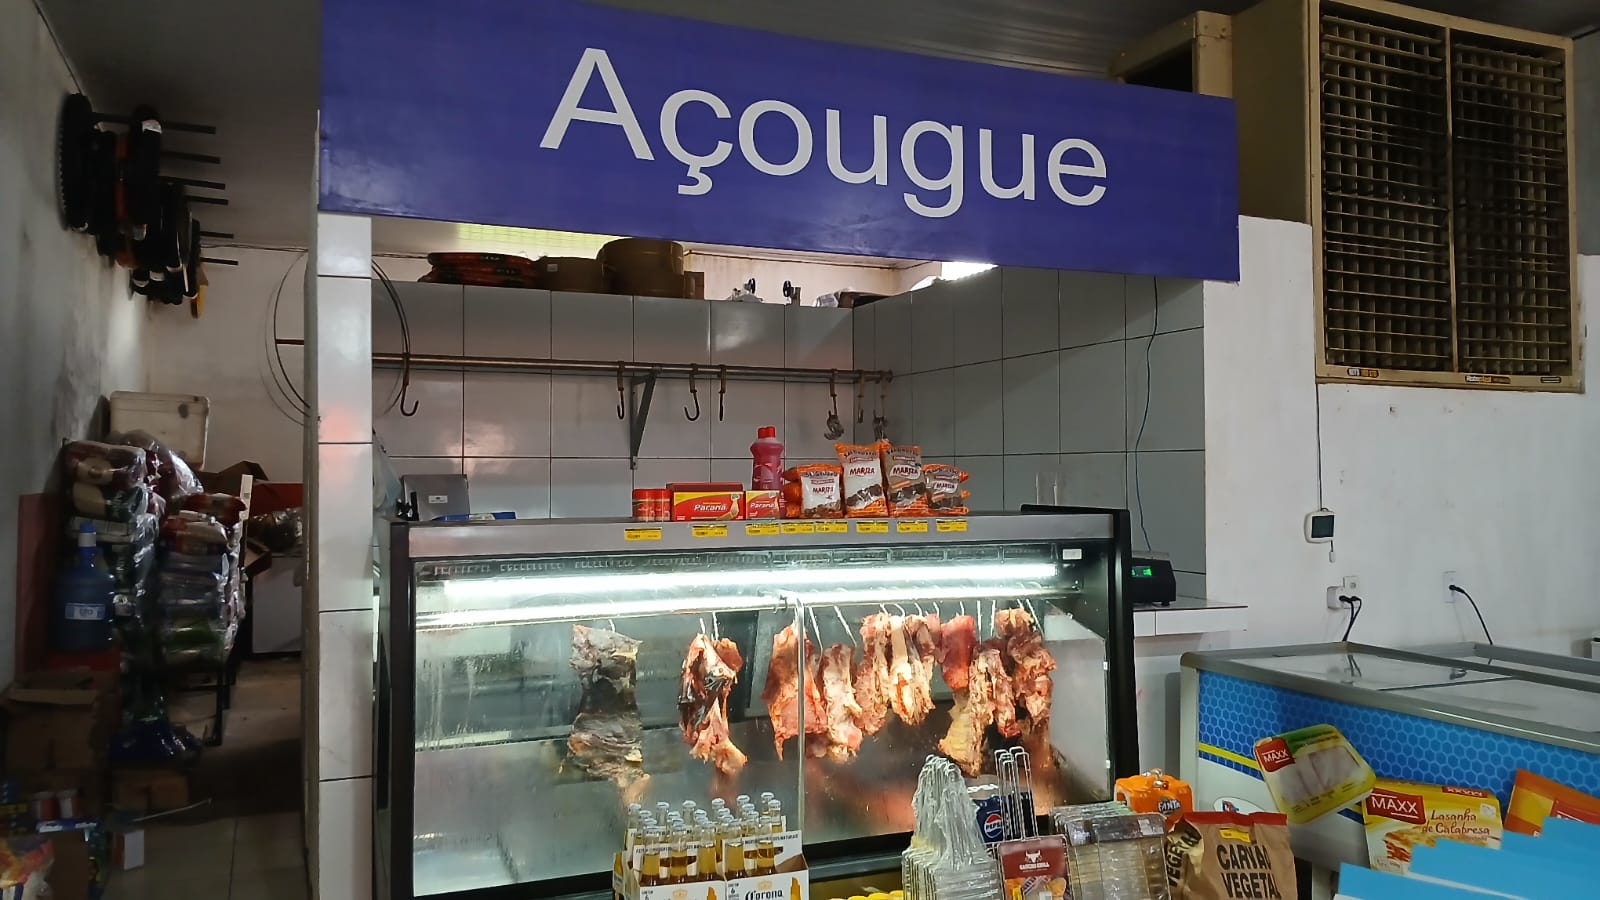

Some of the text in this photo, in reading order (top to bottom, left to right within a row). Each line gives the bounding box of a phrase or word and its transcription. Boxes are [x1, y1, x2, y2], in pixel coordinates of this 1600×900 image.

[539, 47, 1107, 218] Açougue
[850, 467, 875, 476] MARIZA
[1263, 749, 1288, 763] MAXX
[1158, 799, 1181, 811] FANTA
[1371, 797, 1418, 814] MAXX
[1431, 808, 1477, 821] Lasanha
[1422, 822, 1490, 835] de Calabresa
